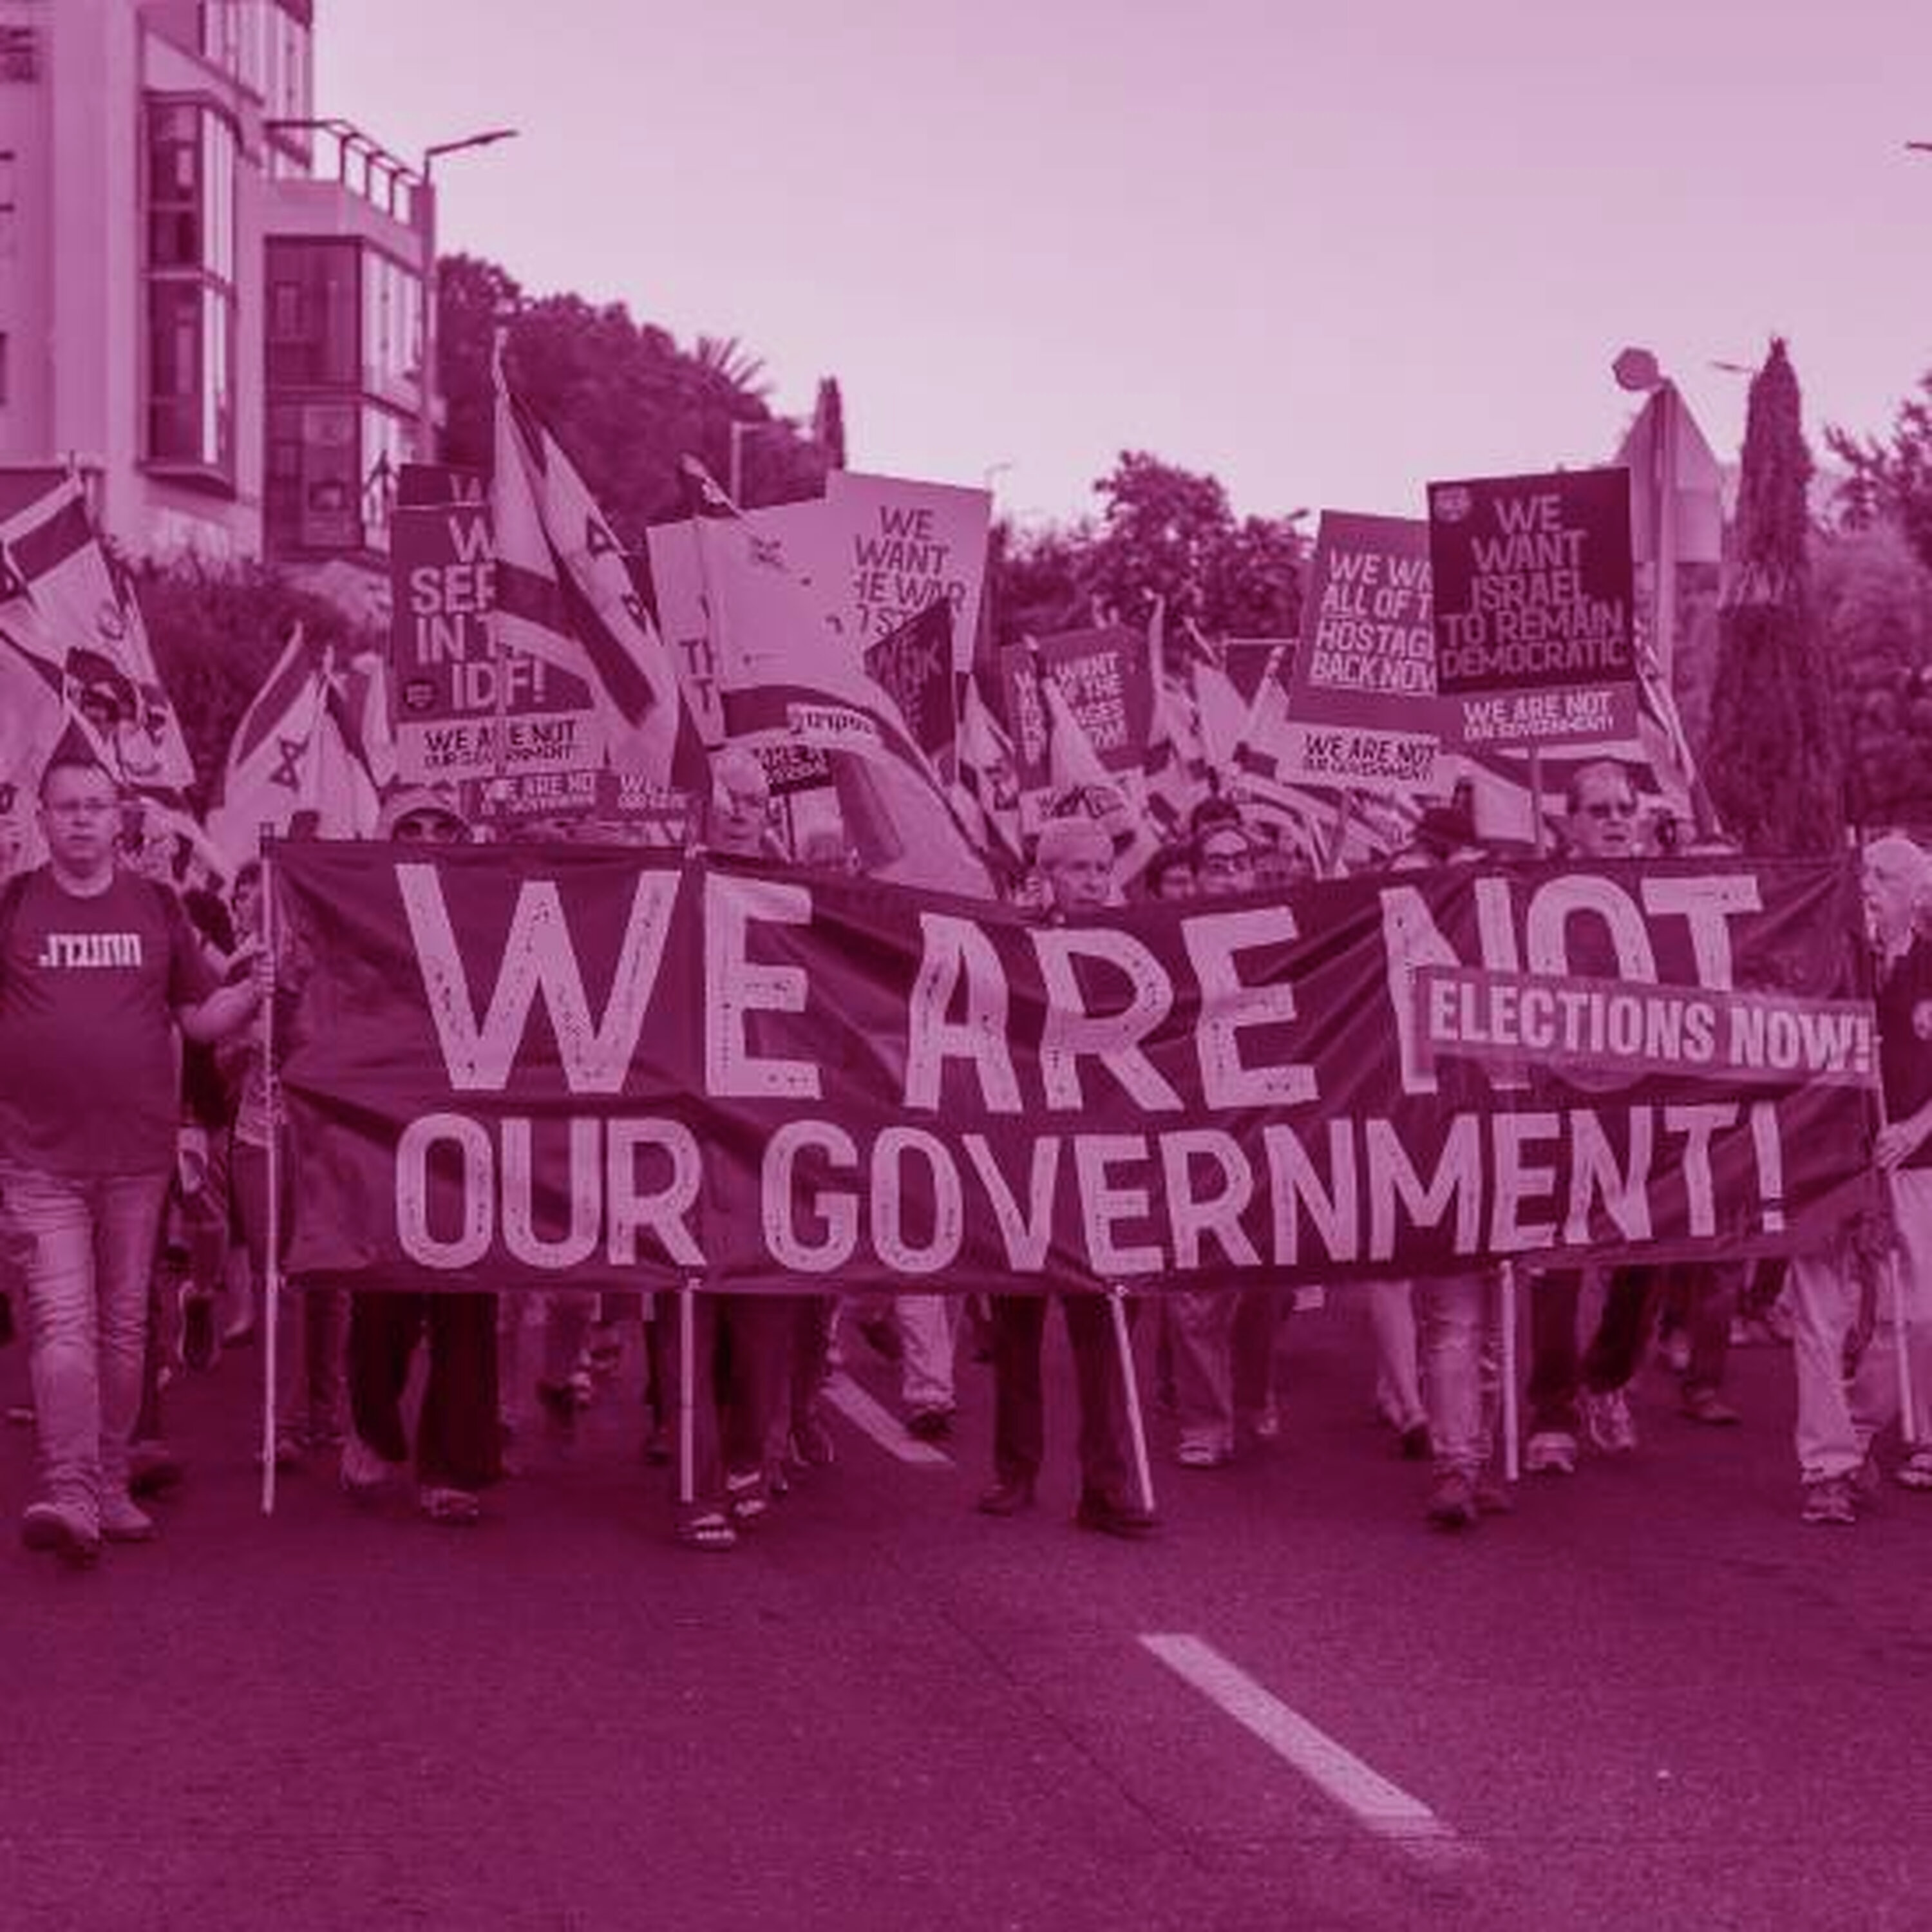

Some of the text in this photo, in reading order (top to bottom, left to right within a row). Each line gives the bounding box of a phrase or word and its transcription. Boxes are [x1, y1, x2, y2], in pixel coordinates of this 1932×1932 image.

[880, 505, 933, 541] WE
[1494, 493, 1561, 535] WE
[855, 534, 951, 576] WANT
[1330, 547, 1434, 592] WE WA
[1471, 529, 1589, 573] WANT
[1321, 582, 1368, 618] ALL
[1373, 587, 1414, 620] OF
[1470, 569, 1591, 611] ISRAEL
[416, 613, 465, 664] IN
[1439, 596, 1624, 647] TO REMAIN
[1441, 638, 1629, 679] DEMOCRATIC
[451, 658, 546, 710] IDF!
[1463, 690, 1614, 724] WE ARE NOT
[424, 728, 469, 753] WE
[1306, 733, 1343, 761] WE
[1348, 738, 1391, 764] ARE
[394, 862, 1764, 1113] WE ARE NOT
[1429, 978, 1870, 1073] ELECTIONS NOW!
[395, 1102, 1785, 1276] OUR GOVERNMENT!
